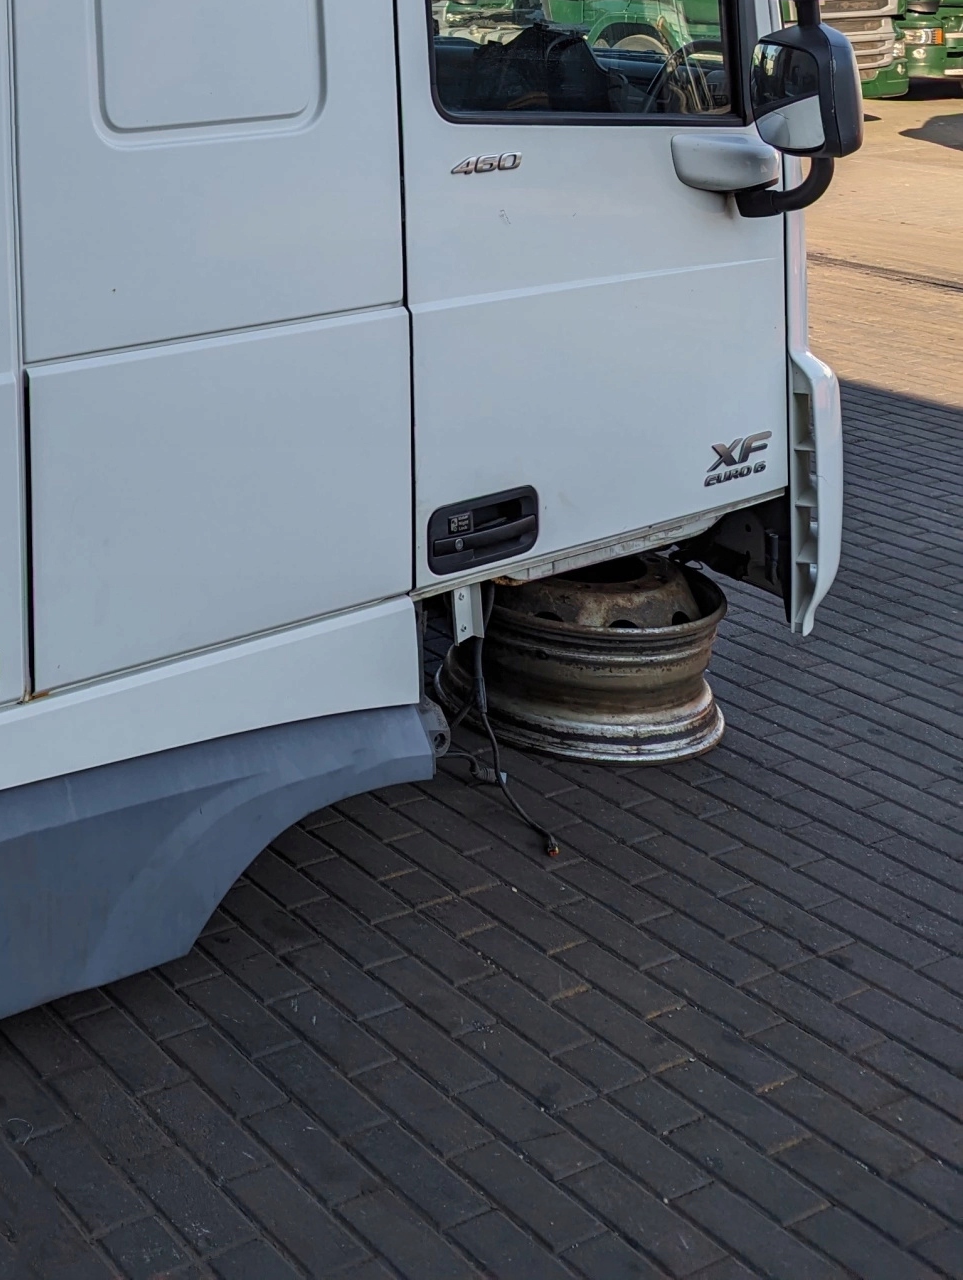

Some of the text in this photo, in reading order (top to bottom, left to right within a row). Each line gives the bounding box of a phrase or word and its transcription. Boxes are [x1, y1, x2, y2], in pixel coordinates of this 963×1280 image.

[451, 151, 522, 175] 460
[707, 430, 772, 473] XF
[704, 460, 766, 487] EURO 6
